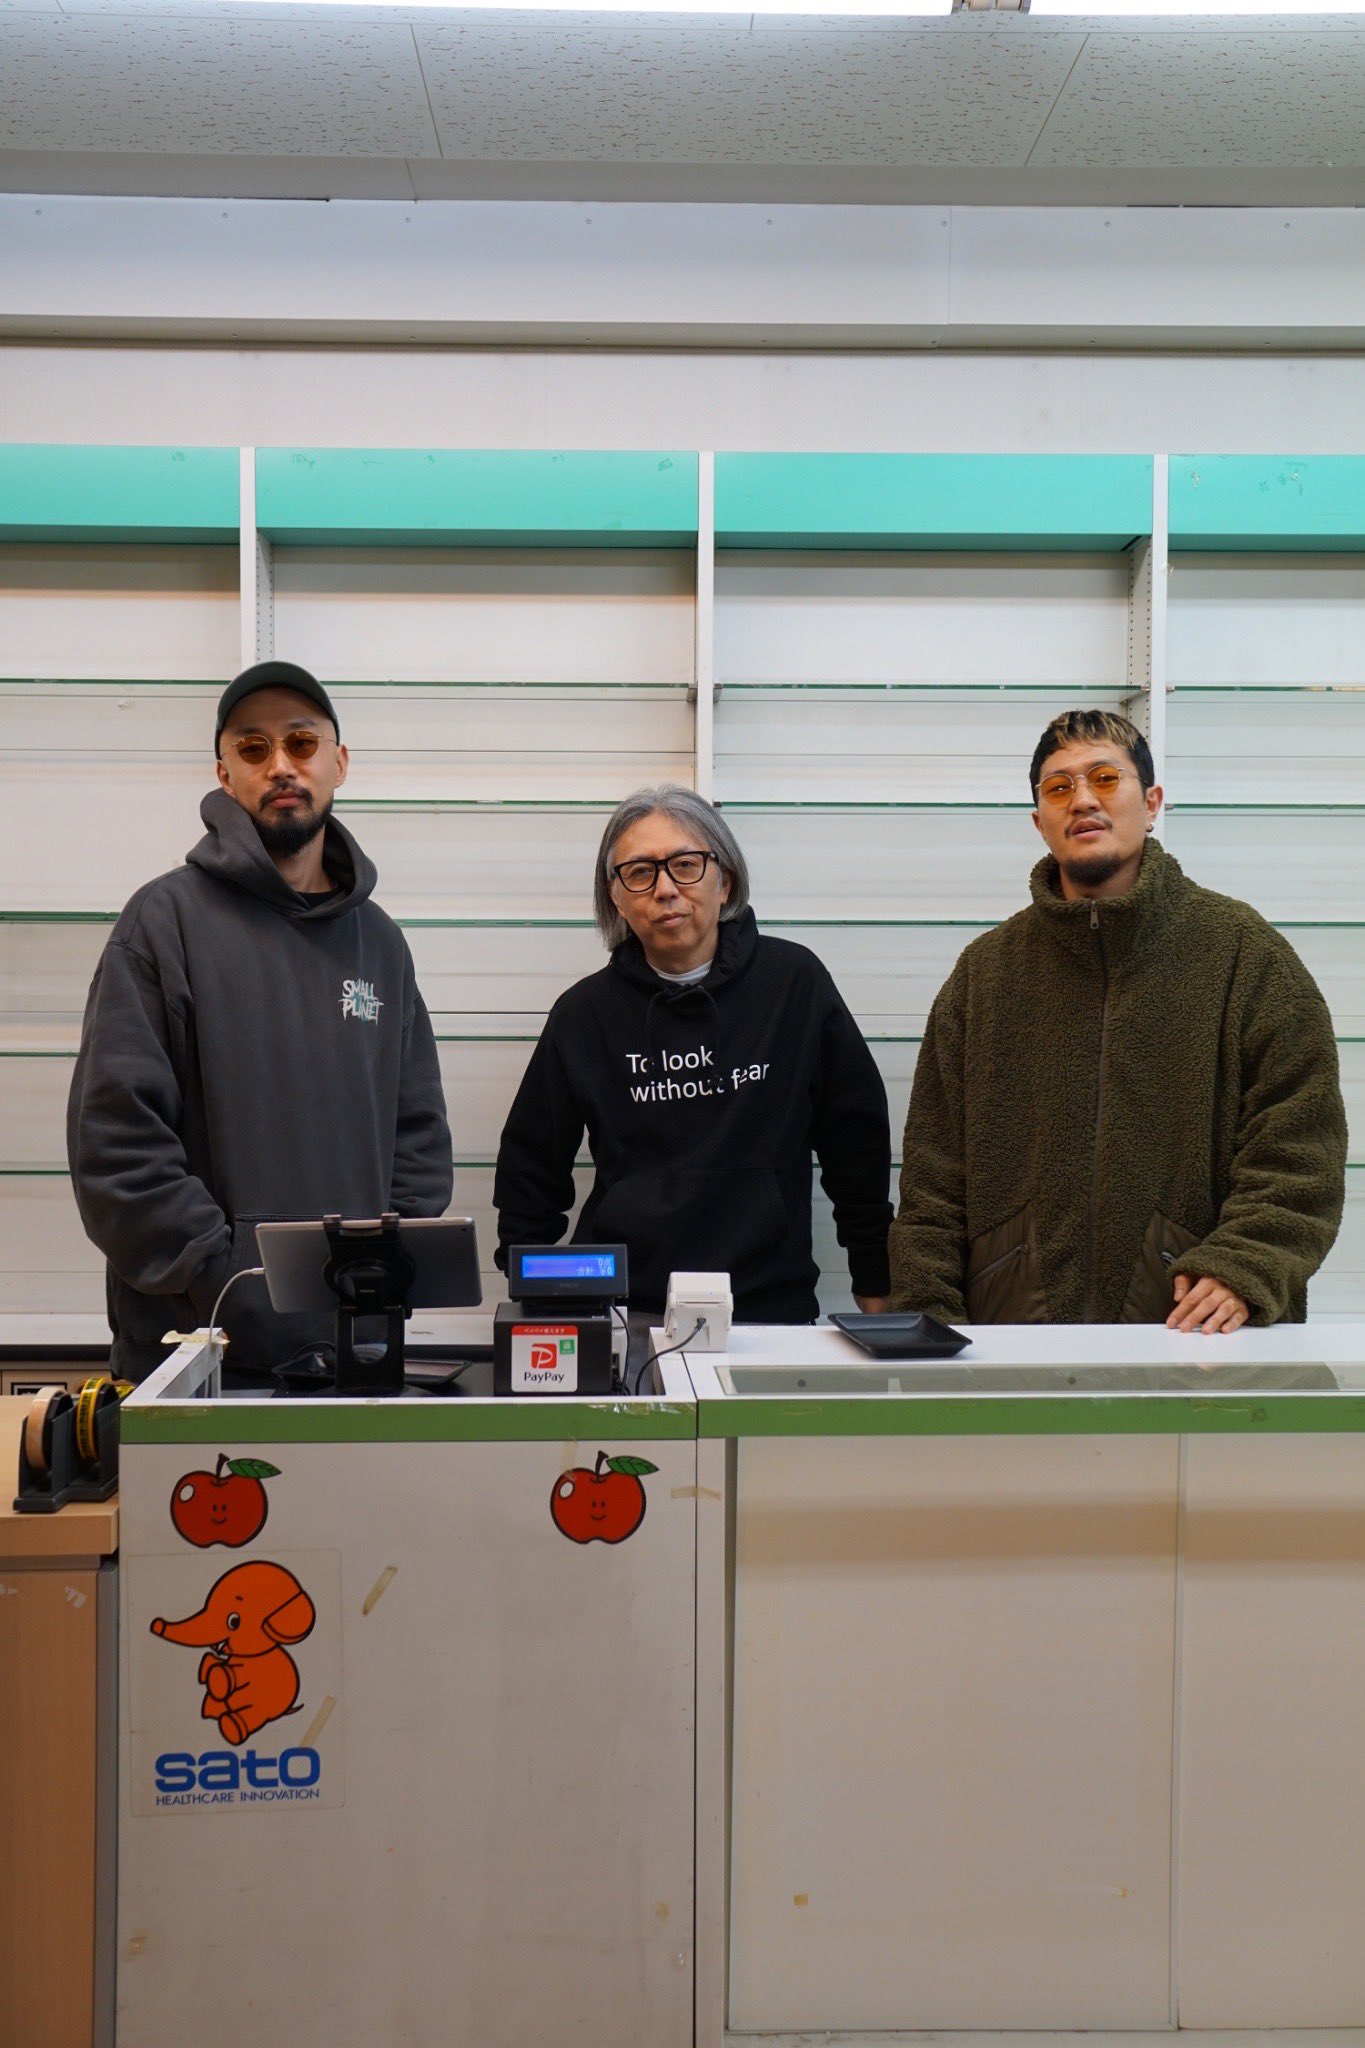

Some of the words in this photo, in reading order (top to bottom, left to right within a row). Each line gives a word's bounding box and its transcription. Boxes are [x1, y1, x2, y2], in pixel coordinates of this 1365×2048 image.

[338, 998, 384, 1026] PLANET
[662, 1046, 714, 1072] look
[524, 1371, 565, 1383] PayPay
[155, 1747, 321, 1793] sato
[156, 1791, 235, 1806] HEALTHCARE
[240, 1788, 320, 1803] INNOVATION
